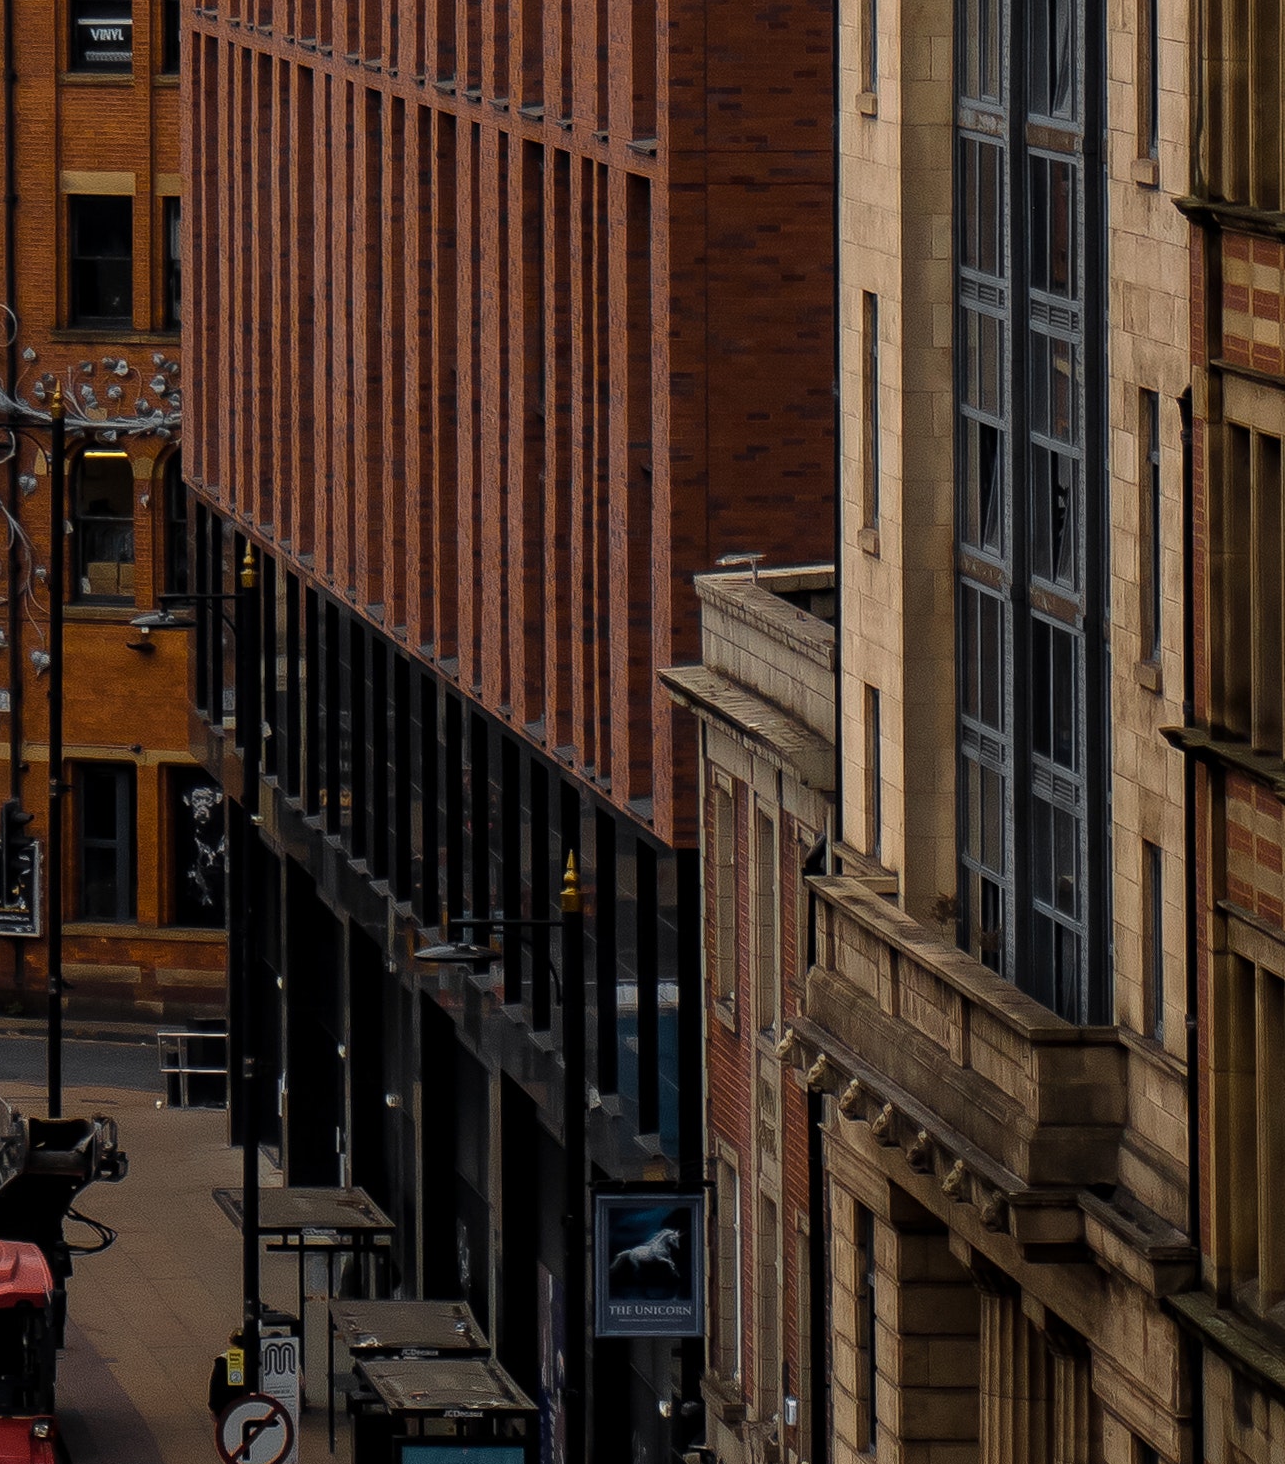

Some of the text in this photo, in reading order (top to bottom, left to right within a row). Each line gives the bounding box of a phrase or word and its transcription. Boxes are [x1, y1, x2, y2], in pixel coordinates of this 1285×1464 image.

[89, 27, 124, 41] VINYL
[609, 1305, 692, 1317] THE UNICORN
